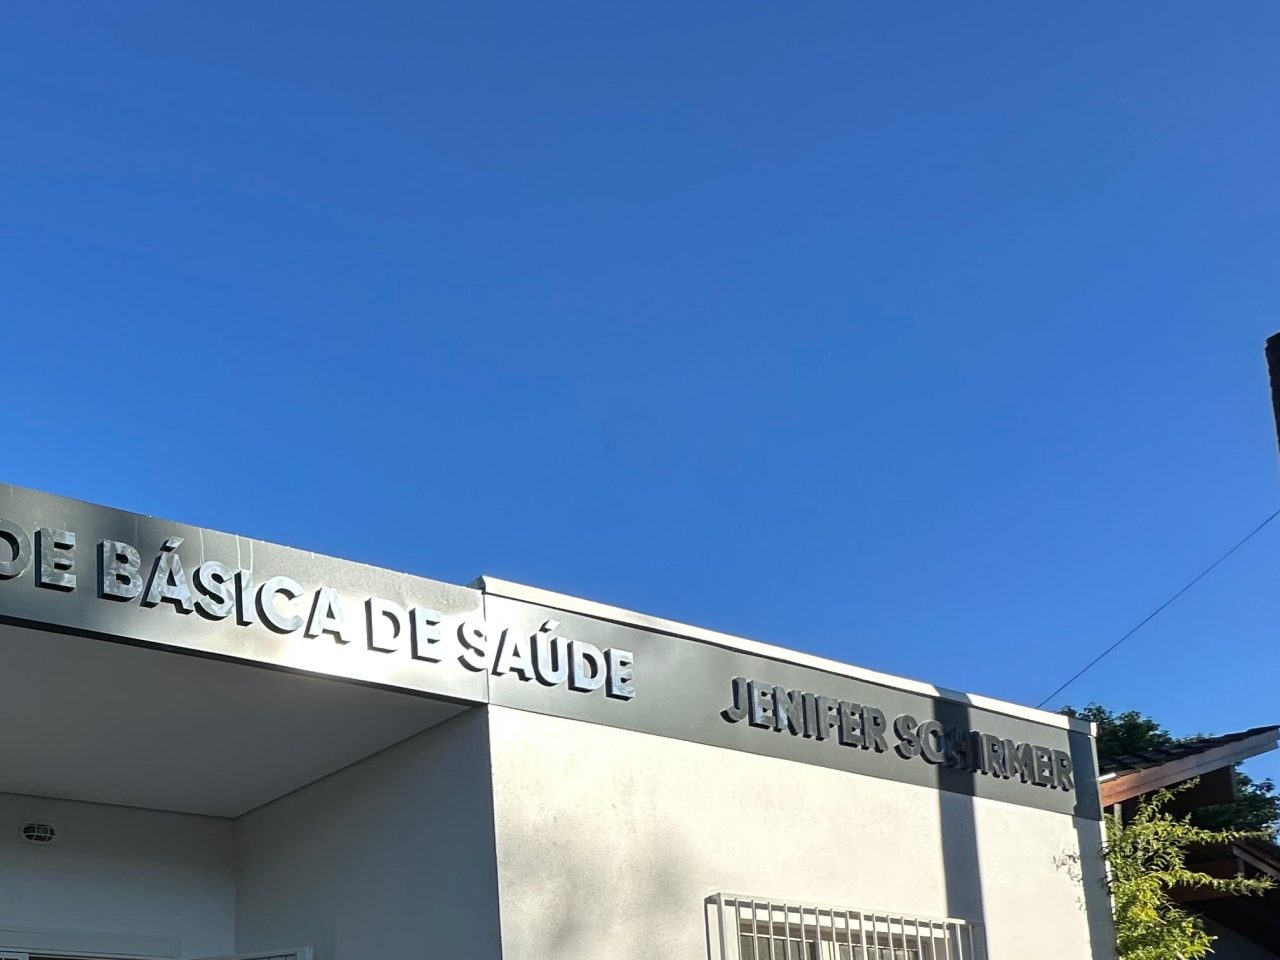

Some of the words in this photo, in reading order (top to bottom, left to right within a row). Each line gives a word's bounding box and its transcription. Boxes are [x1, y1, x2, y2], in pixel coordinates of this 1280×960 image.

[96, 536, 351, 645] BÁSICA
[366, 597, 443, 663] DE
[457, 618, 636, 701] SAÚDE
[720, 676, 890, 753] JENIFER
[893, 714, 1075, 791] SCHIRMER
